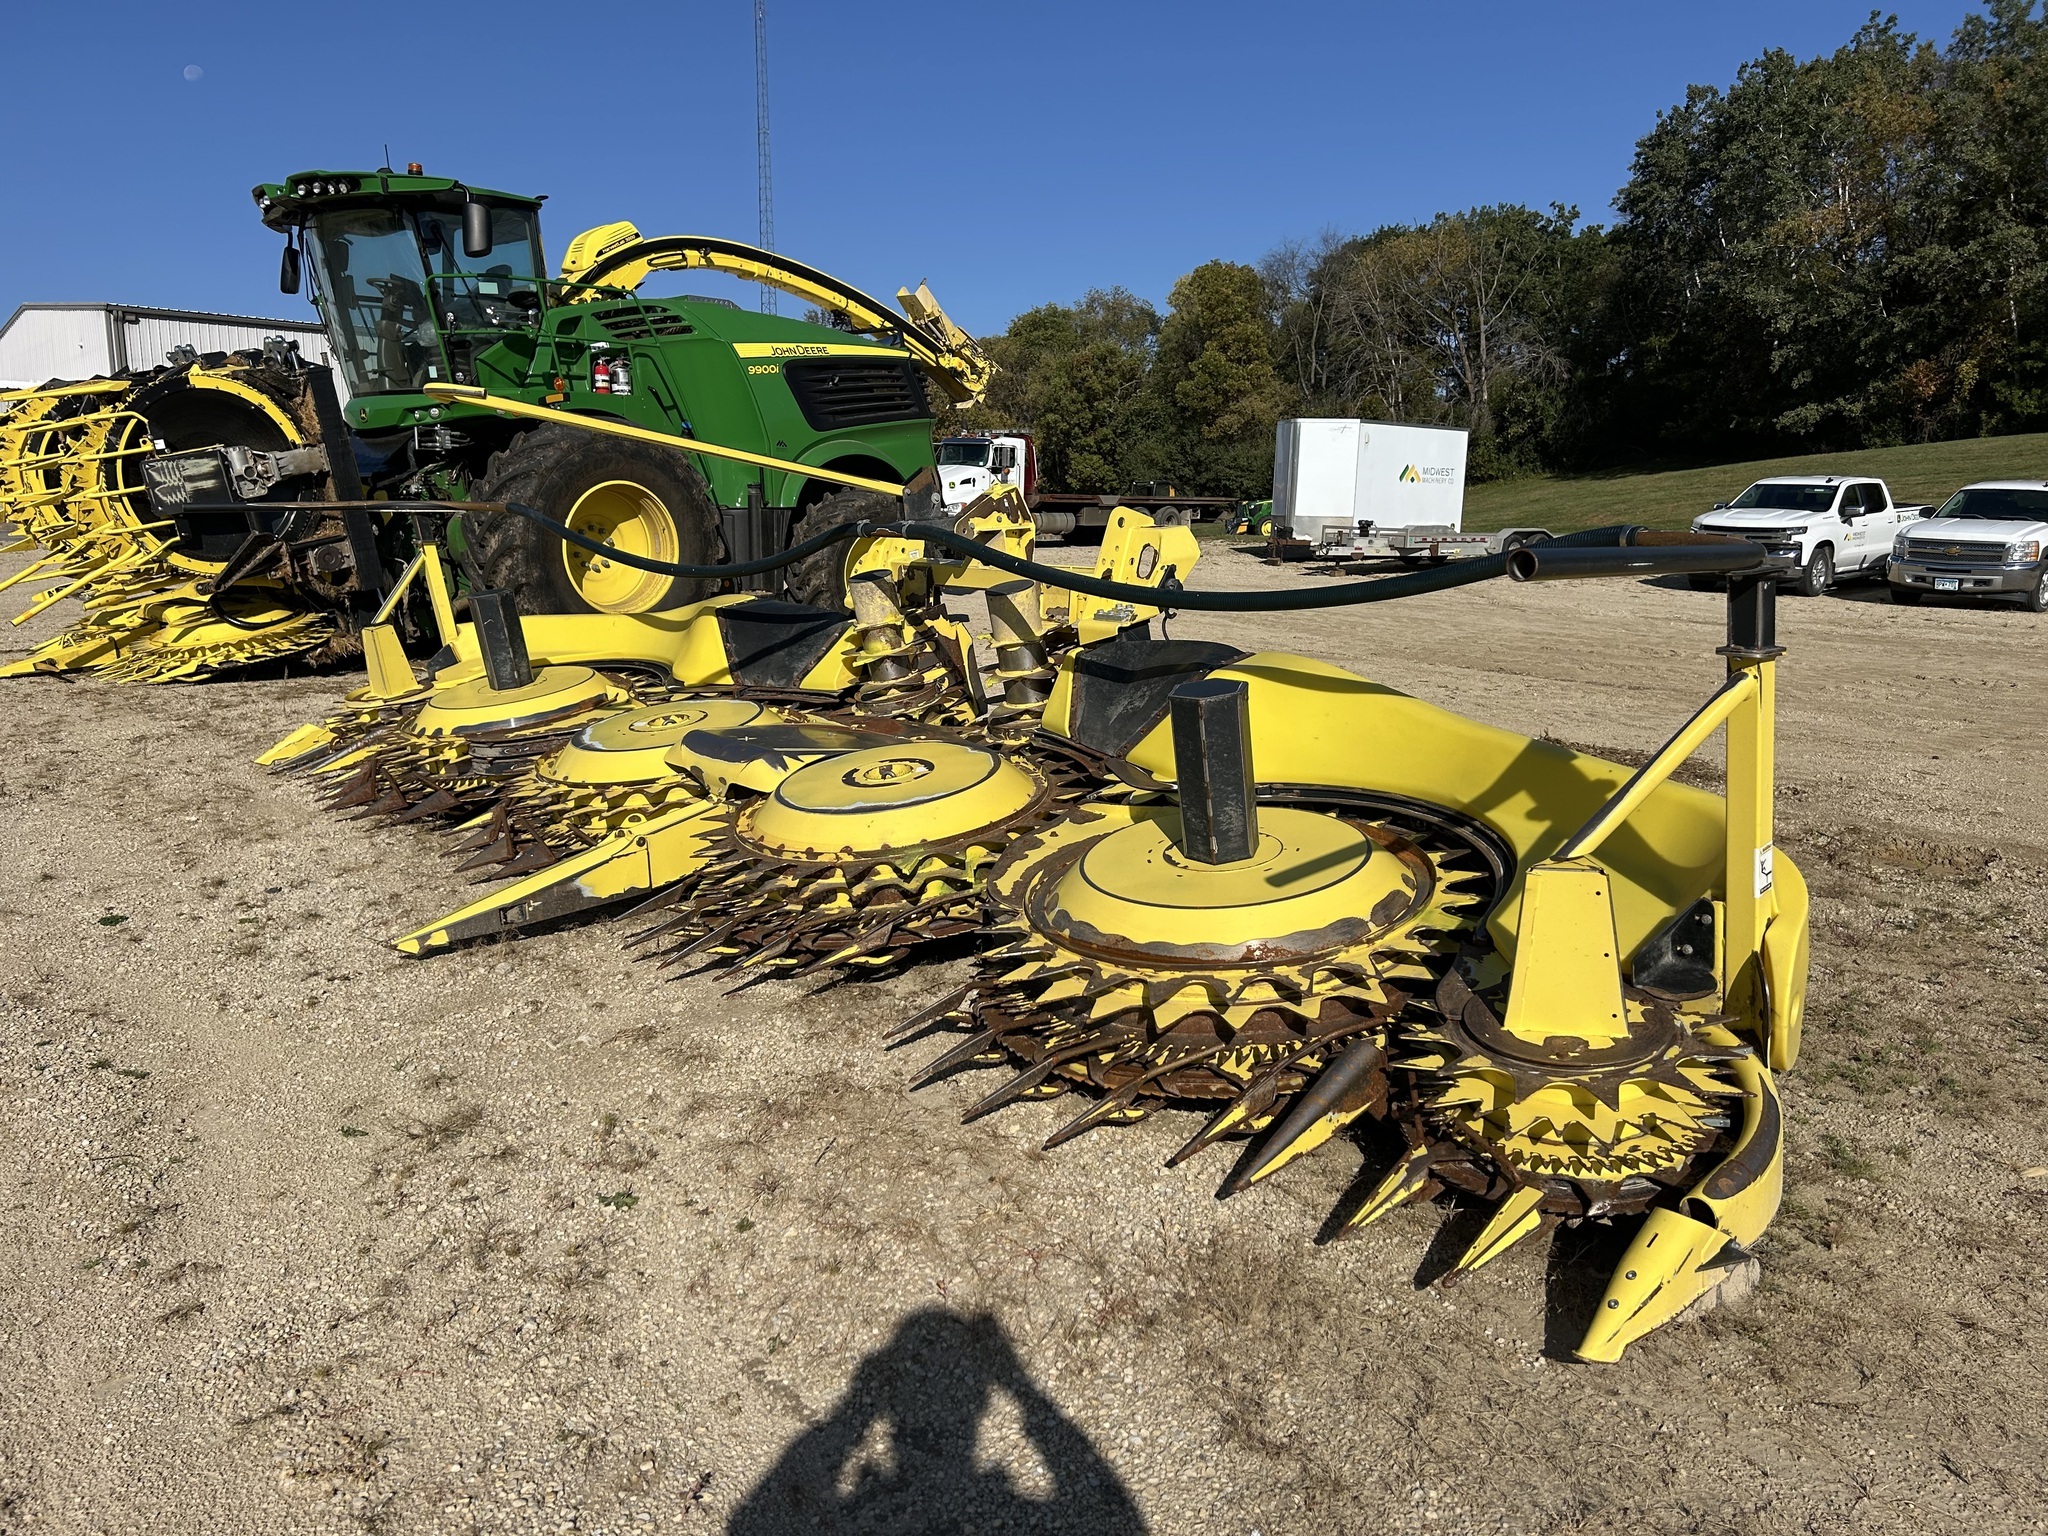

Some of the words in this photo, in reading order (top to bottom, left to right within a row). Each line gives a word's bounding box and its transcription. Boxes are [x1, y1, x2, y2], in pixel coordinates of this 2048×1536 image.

[771, 345, 797, 356] JOHN
[796, 345, 829, 355] DEERE
[748, 364, 779, 375] 9900i
[1422, 467, 1455, 477] MIDWEST
